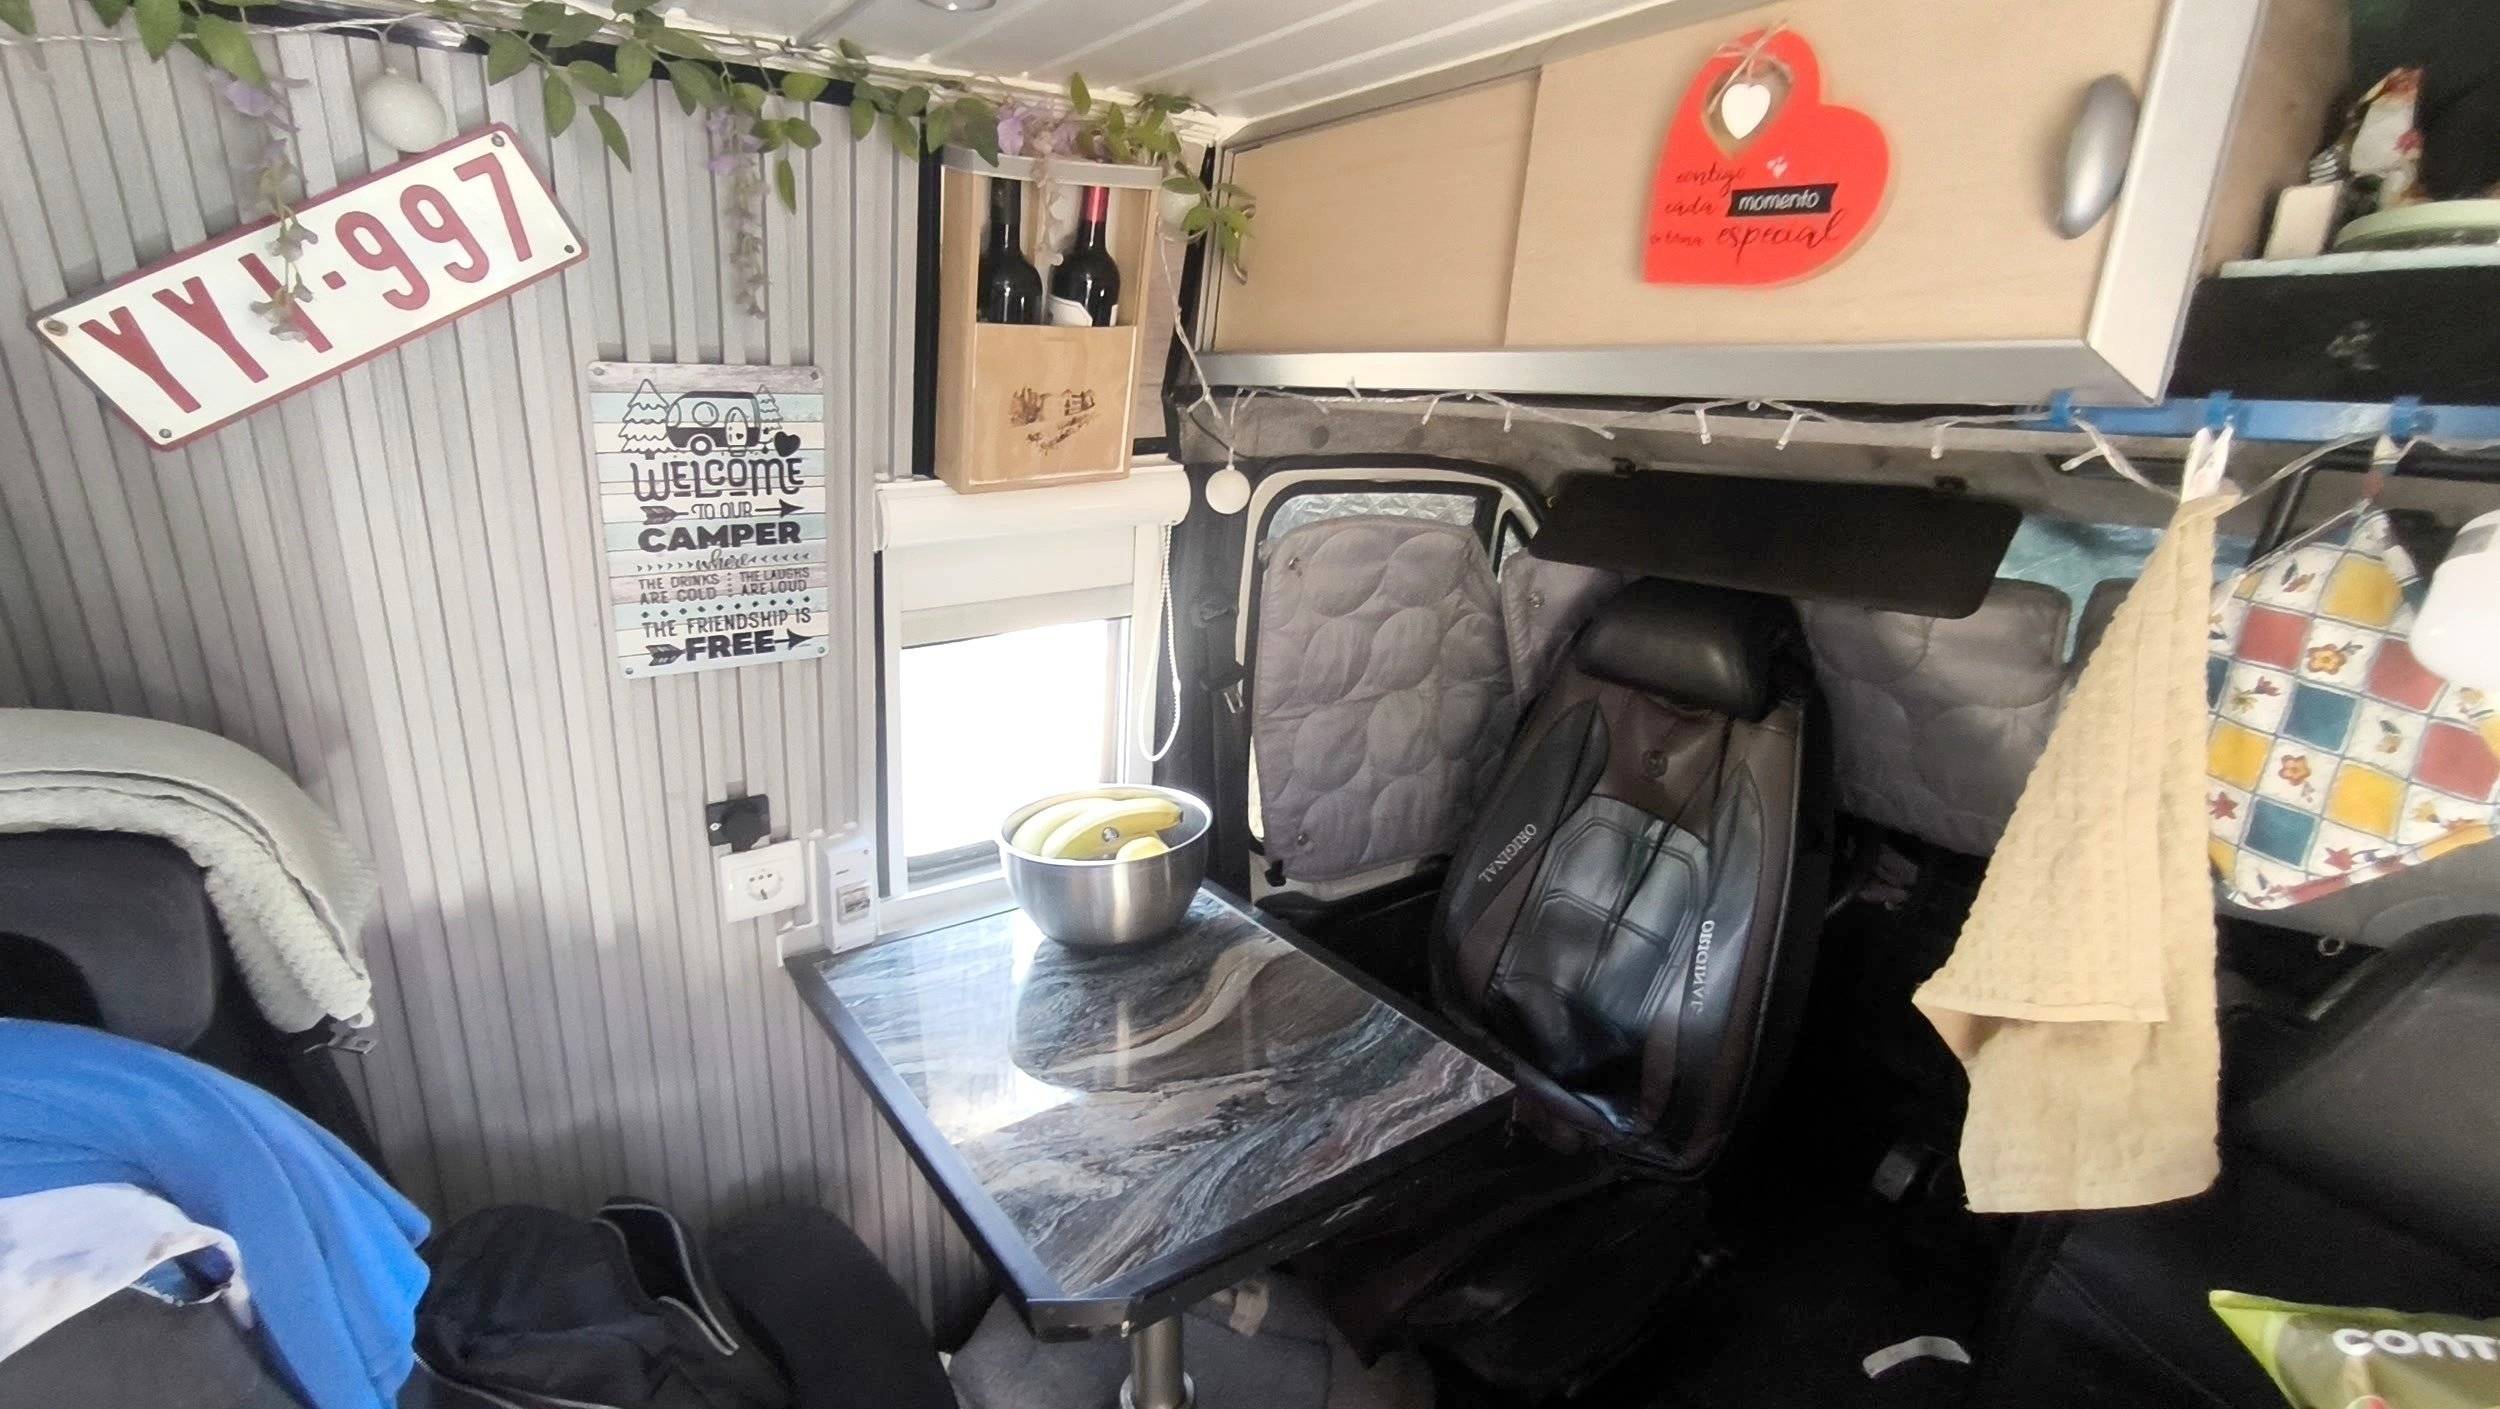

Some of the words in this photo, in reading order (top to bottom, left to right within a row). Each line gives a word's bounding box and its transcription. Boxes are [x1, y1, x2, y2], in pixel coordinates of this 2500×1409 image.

[1738, 189, 1820, 211] momento
[1716, 207, 1844, 265] especial
[630, 457, 804, 502] WELCOME
[691, 503, 715, 520] TO
[720, 501, 752, 519] OUR
[638, 521, 801, 553] CAMPER
[638, 577, 663, 591] THE
[671, 573, 721, 589] DRINKS
[739, 570, 763, 583] THE
[763, 567, 810, 580] LAUGHS
[741, 583, 766, 596] ARE
[769, 579, 807, 594] LOUD
[640, 590, 669, 606] ARE
[677, 587, 717, 602] COLD
[642, 619, 677, 639] THE
[686, 609, 789, 635] FRIENDSHIP
[795, 607, 812, 624] IS
[685, 629, 776, 662] FREE
[1478, 823, 1537, 883] ORIGINAL
[2332, 1328, 2500, 1361] CONT
